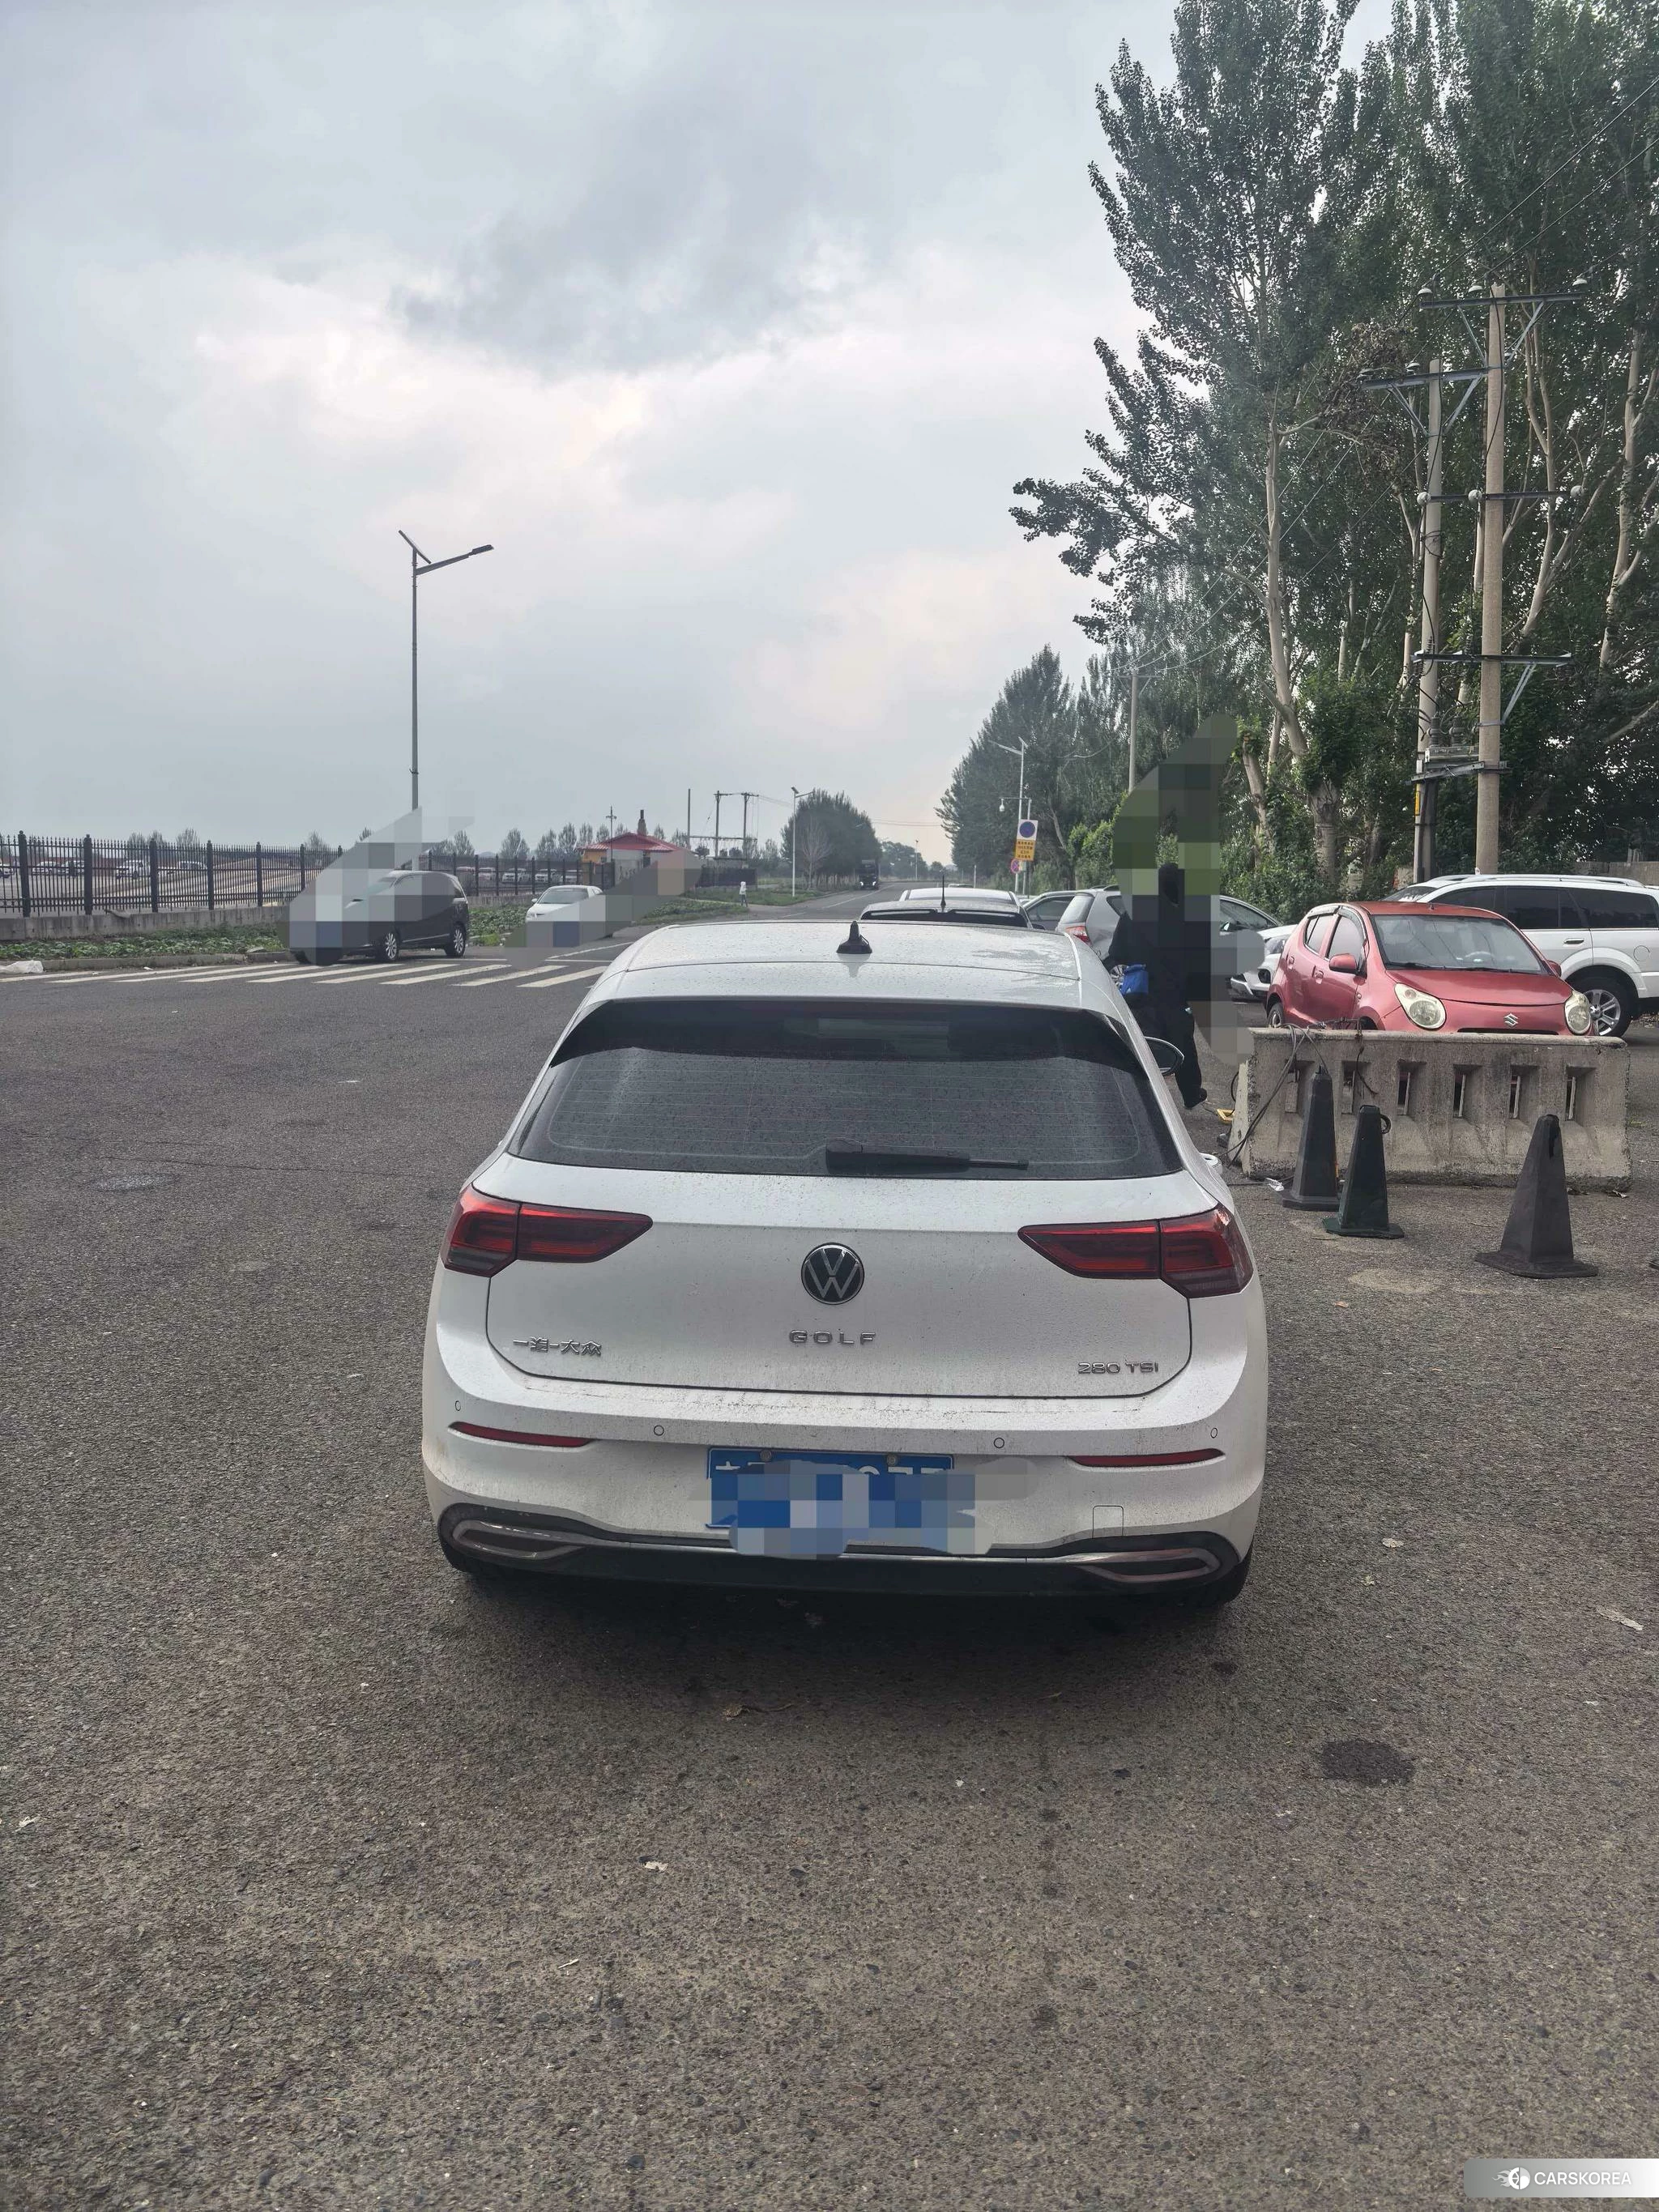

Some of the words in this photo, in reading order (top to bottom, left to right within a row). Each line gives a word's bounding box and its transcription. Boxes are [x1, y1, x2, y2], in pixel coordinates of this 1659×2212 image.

[789, 1330, 876, 1345] GOLF
[1078, 1362, 1121, 1375] 280
[1125, 1361, 1159, 1373] TSI
